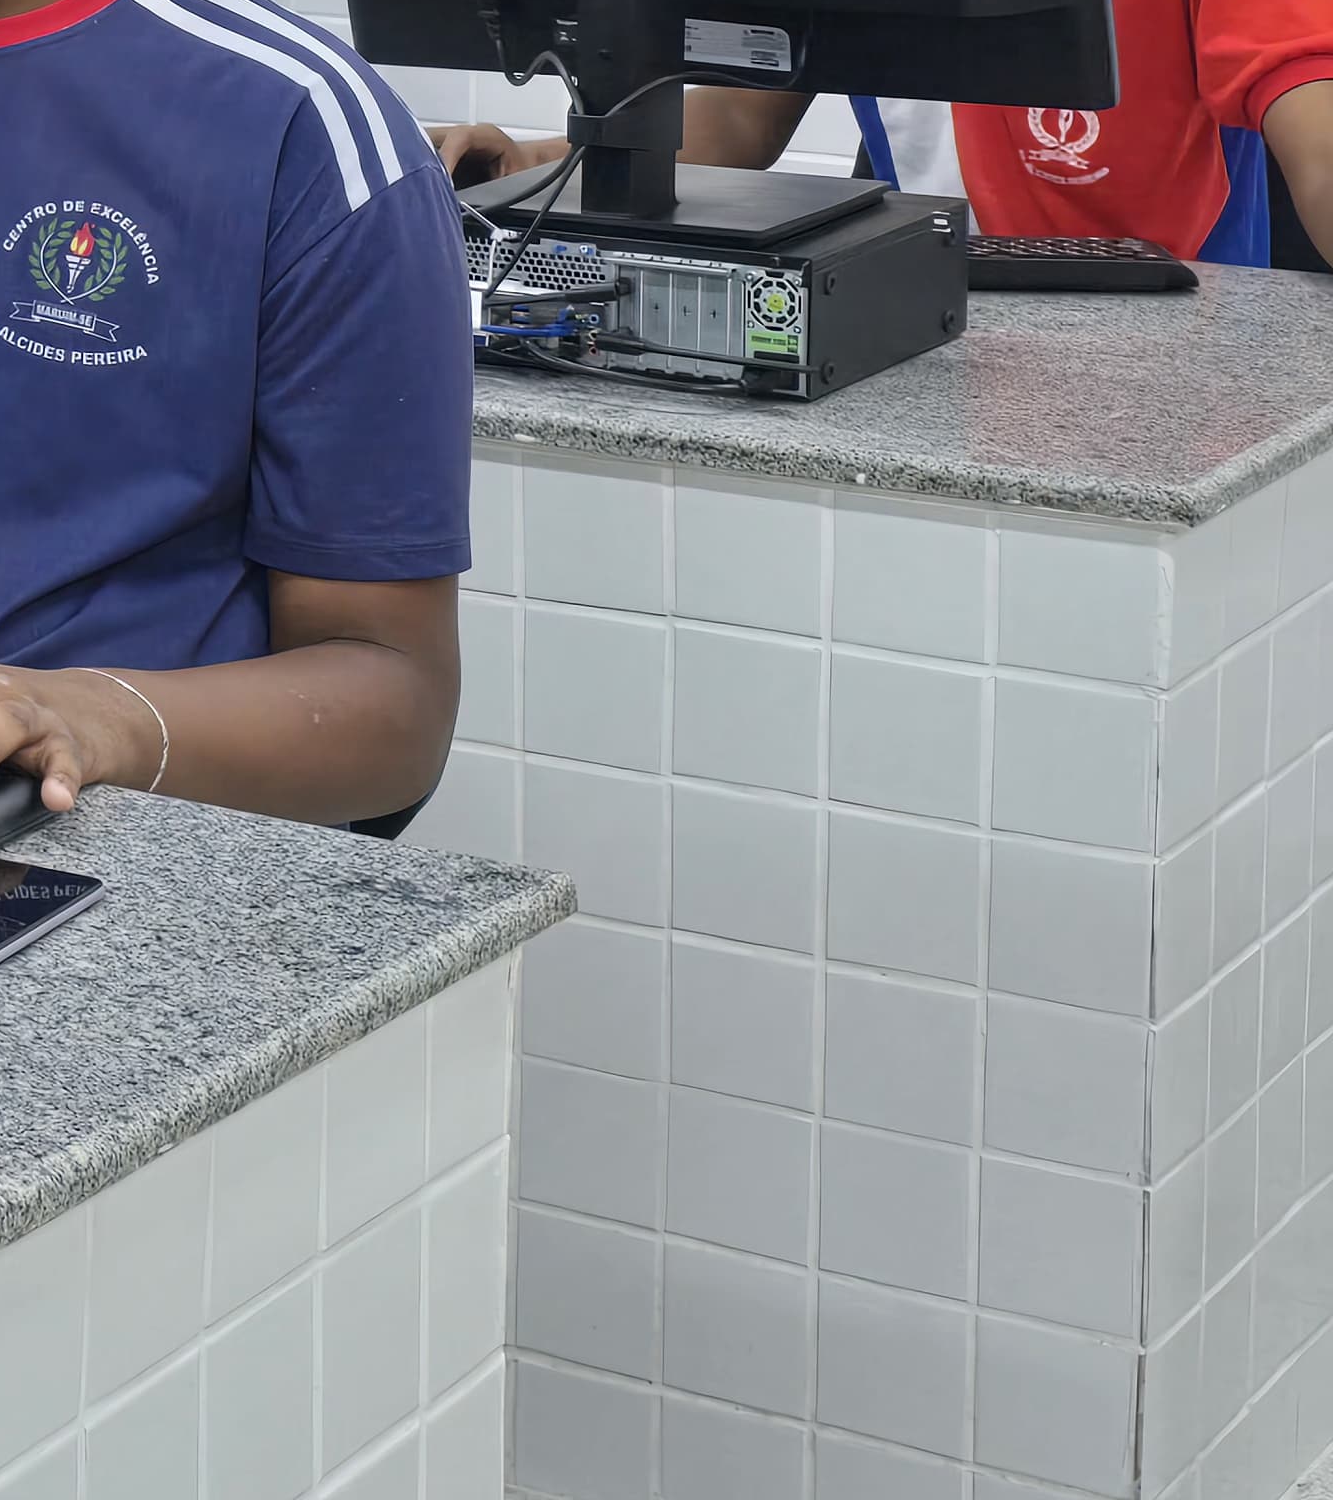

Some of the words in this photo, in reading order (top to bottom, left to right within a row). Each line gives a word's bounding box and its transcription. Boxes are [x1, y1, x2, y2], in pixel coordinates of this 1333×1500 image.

[2, 202, 57, 251] CENTRO
[63, 201, 85, 212] DE
[90, 202, 159, 285] EXCELÊNCIA
[71, 345, 148, 366] PEREIRA
